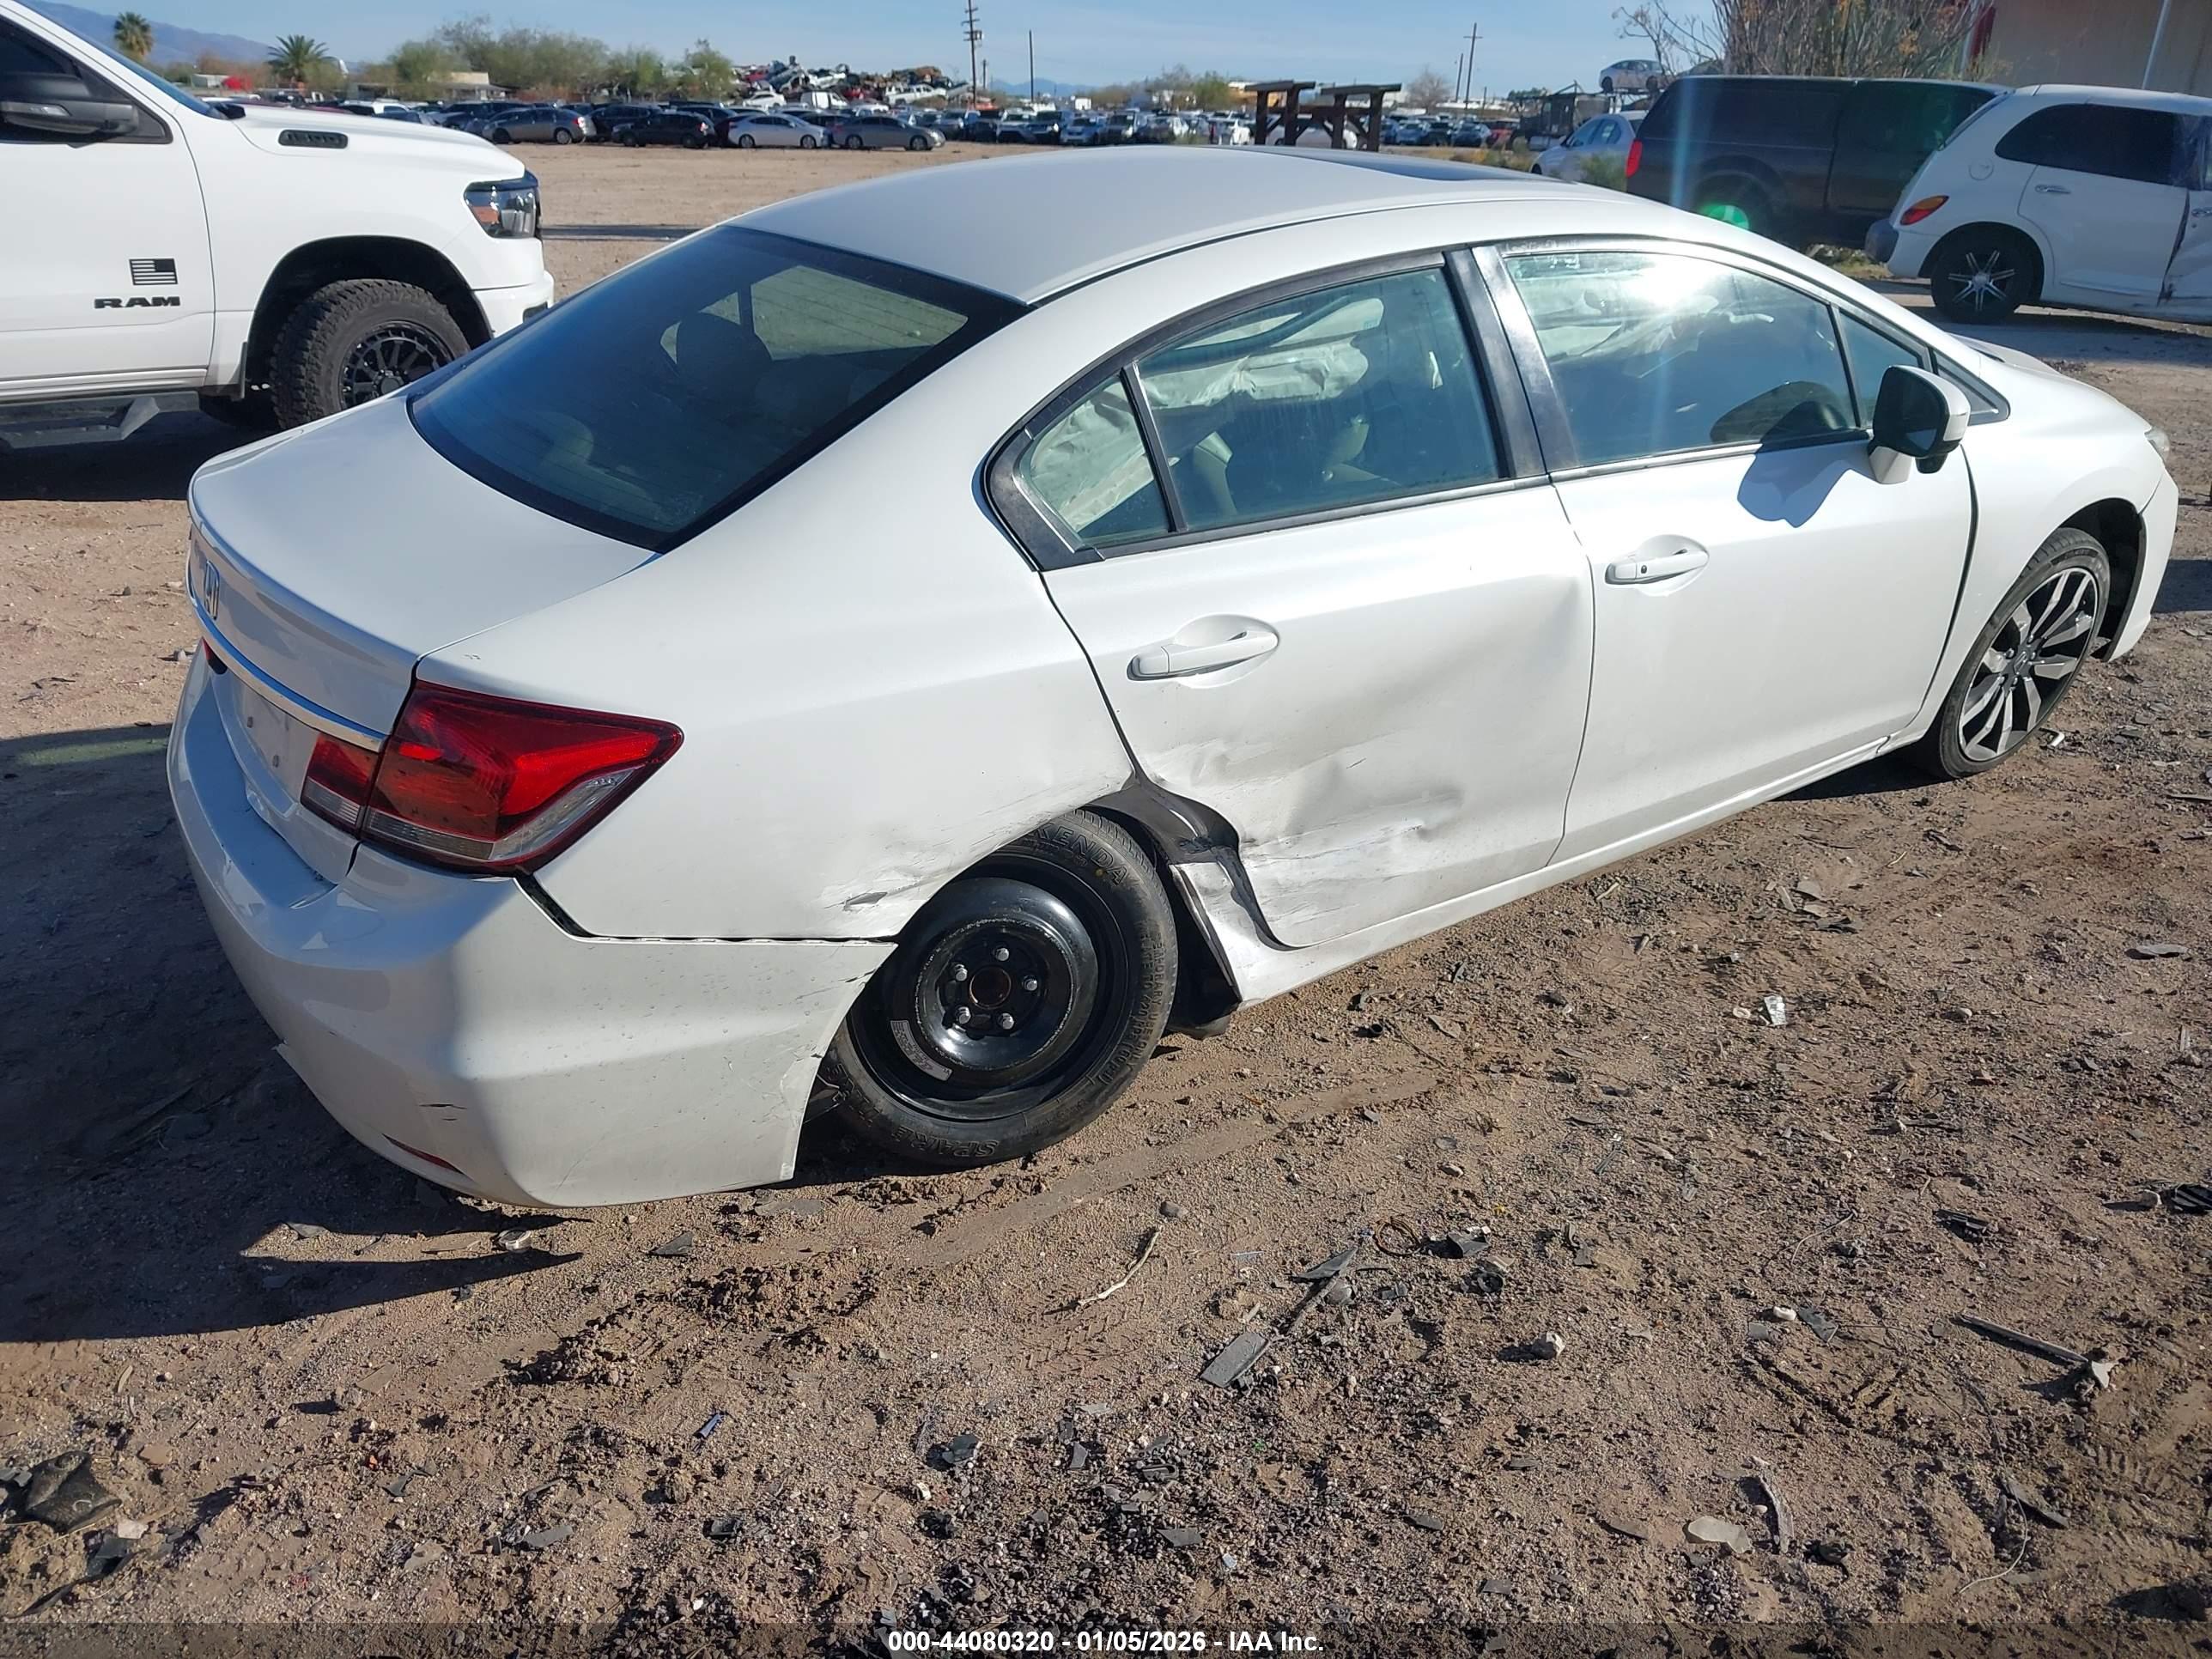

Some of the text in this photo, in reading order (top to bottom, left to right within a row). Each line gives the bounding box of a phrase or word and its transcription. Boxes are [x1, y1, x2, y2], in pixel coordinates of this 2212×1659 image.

[94, 296, 181, 309] RAM
[1030, 822, 1127, 885] KENDA
[891, 1126, 1000, 1158] SPARE
